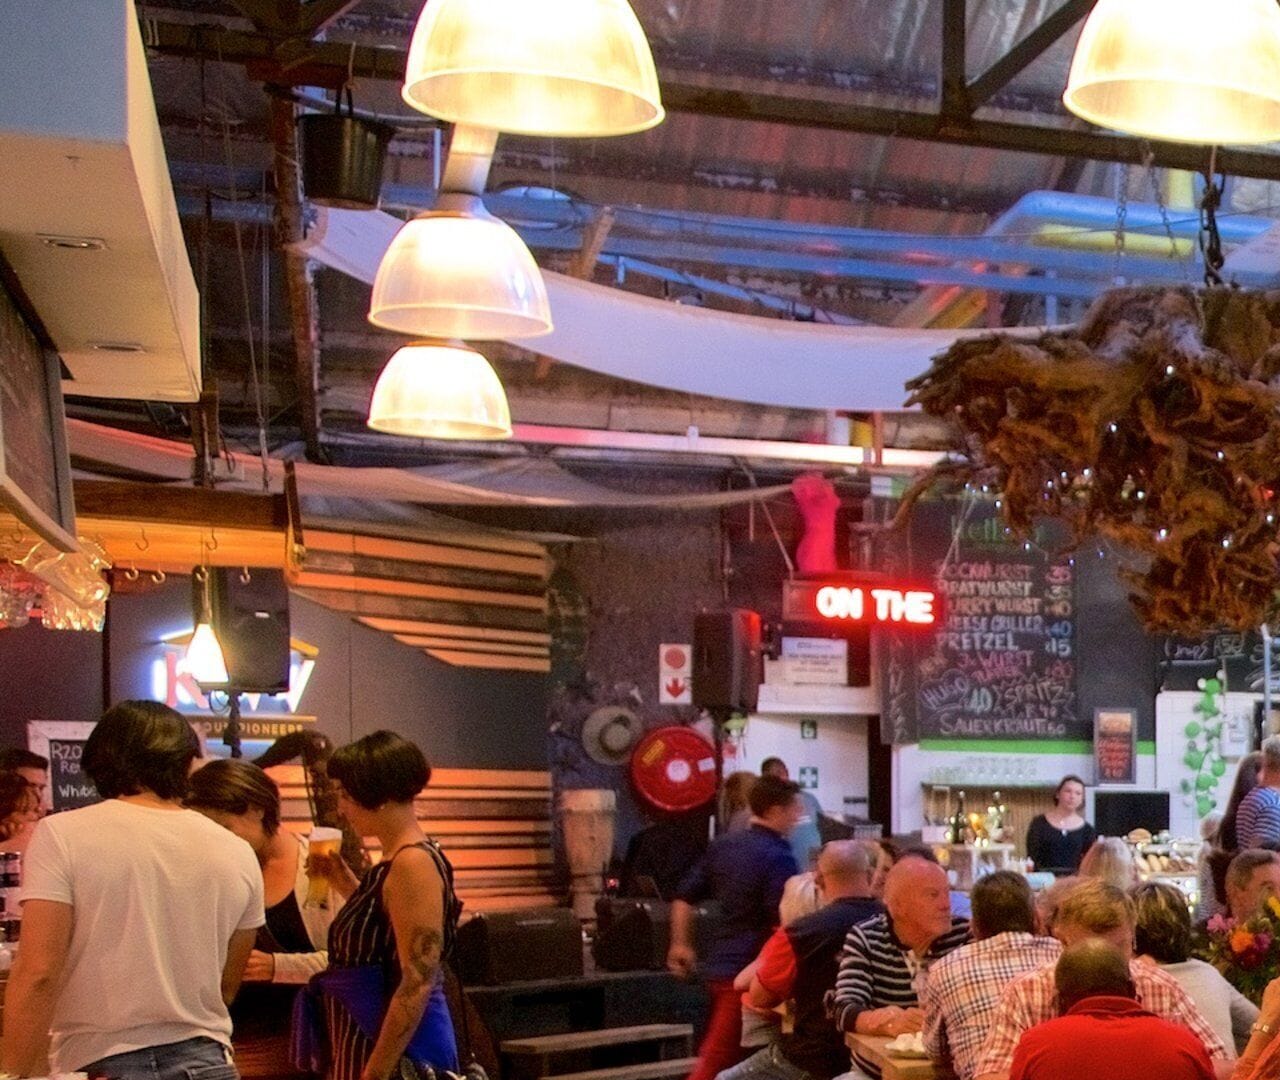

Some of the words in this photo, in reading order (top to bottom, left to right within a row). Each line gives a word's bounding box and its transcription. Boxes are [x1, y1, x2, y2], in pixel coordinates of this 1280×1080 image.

[815, 585, 863, 620] ON
[871, 587, 936, 625] THE
[936, 632, 1020, 651] PRETZEL
